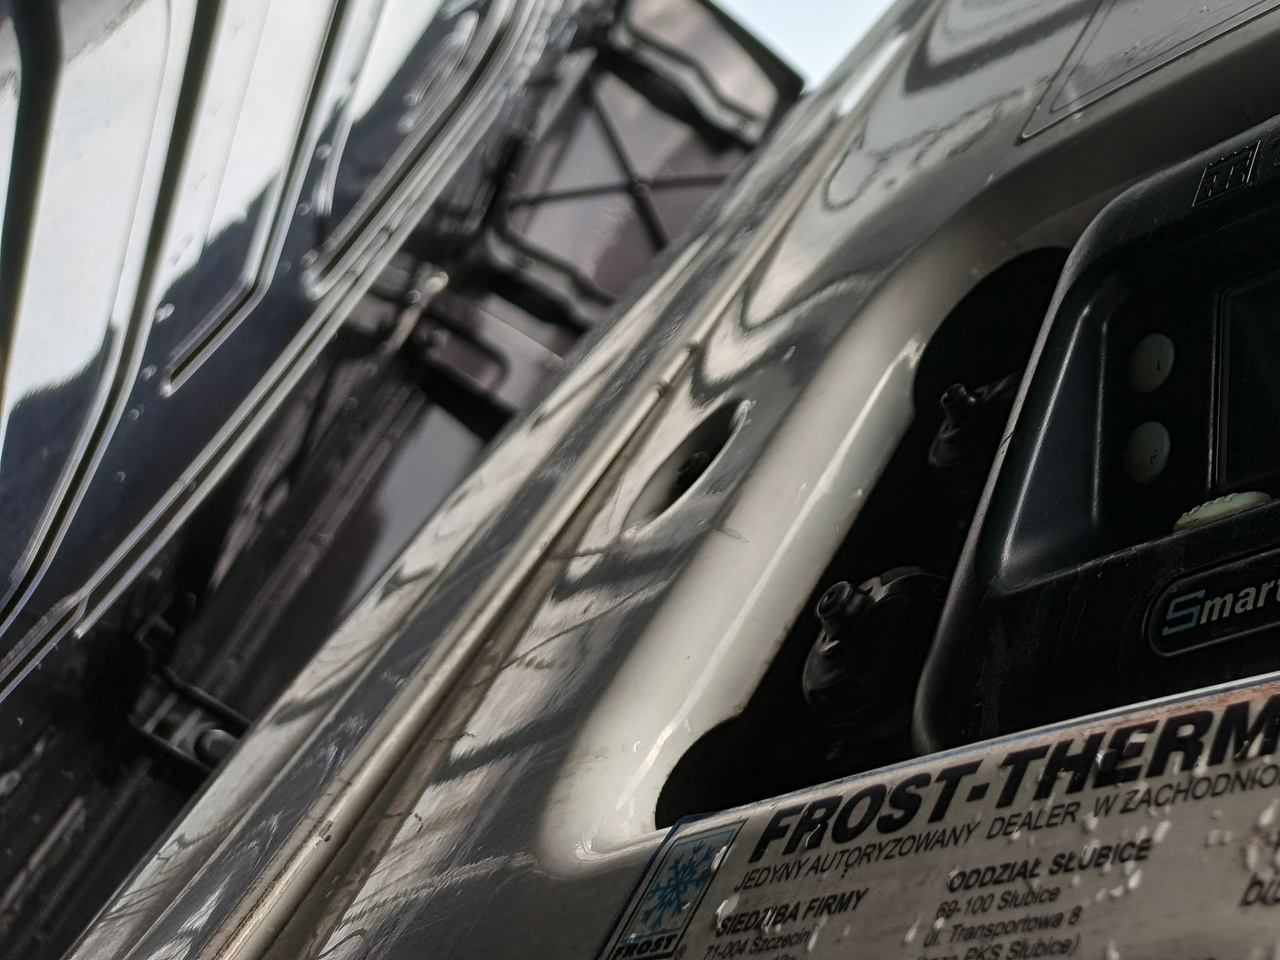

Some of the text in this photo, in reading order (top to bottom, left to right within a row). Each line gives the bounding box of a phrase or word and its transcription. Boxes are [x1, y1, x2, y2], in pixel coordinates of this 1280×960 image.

[734, 859, 806, 892] JEDYNY
[804, 821, 981, 877] AUTORYZOWANY
[986, 801, 1081, 839] DEALER
[1093, 794, 1120, 817] W
[802, 886, 870, 921] FIRMY
